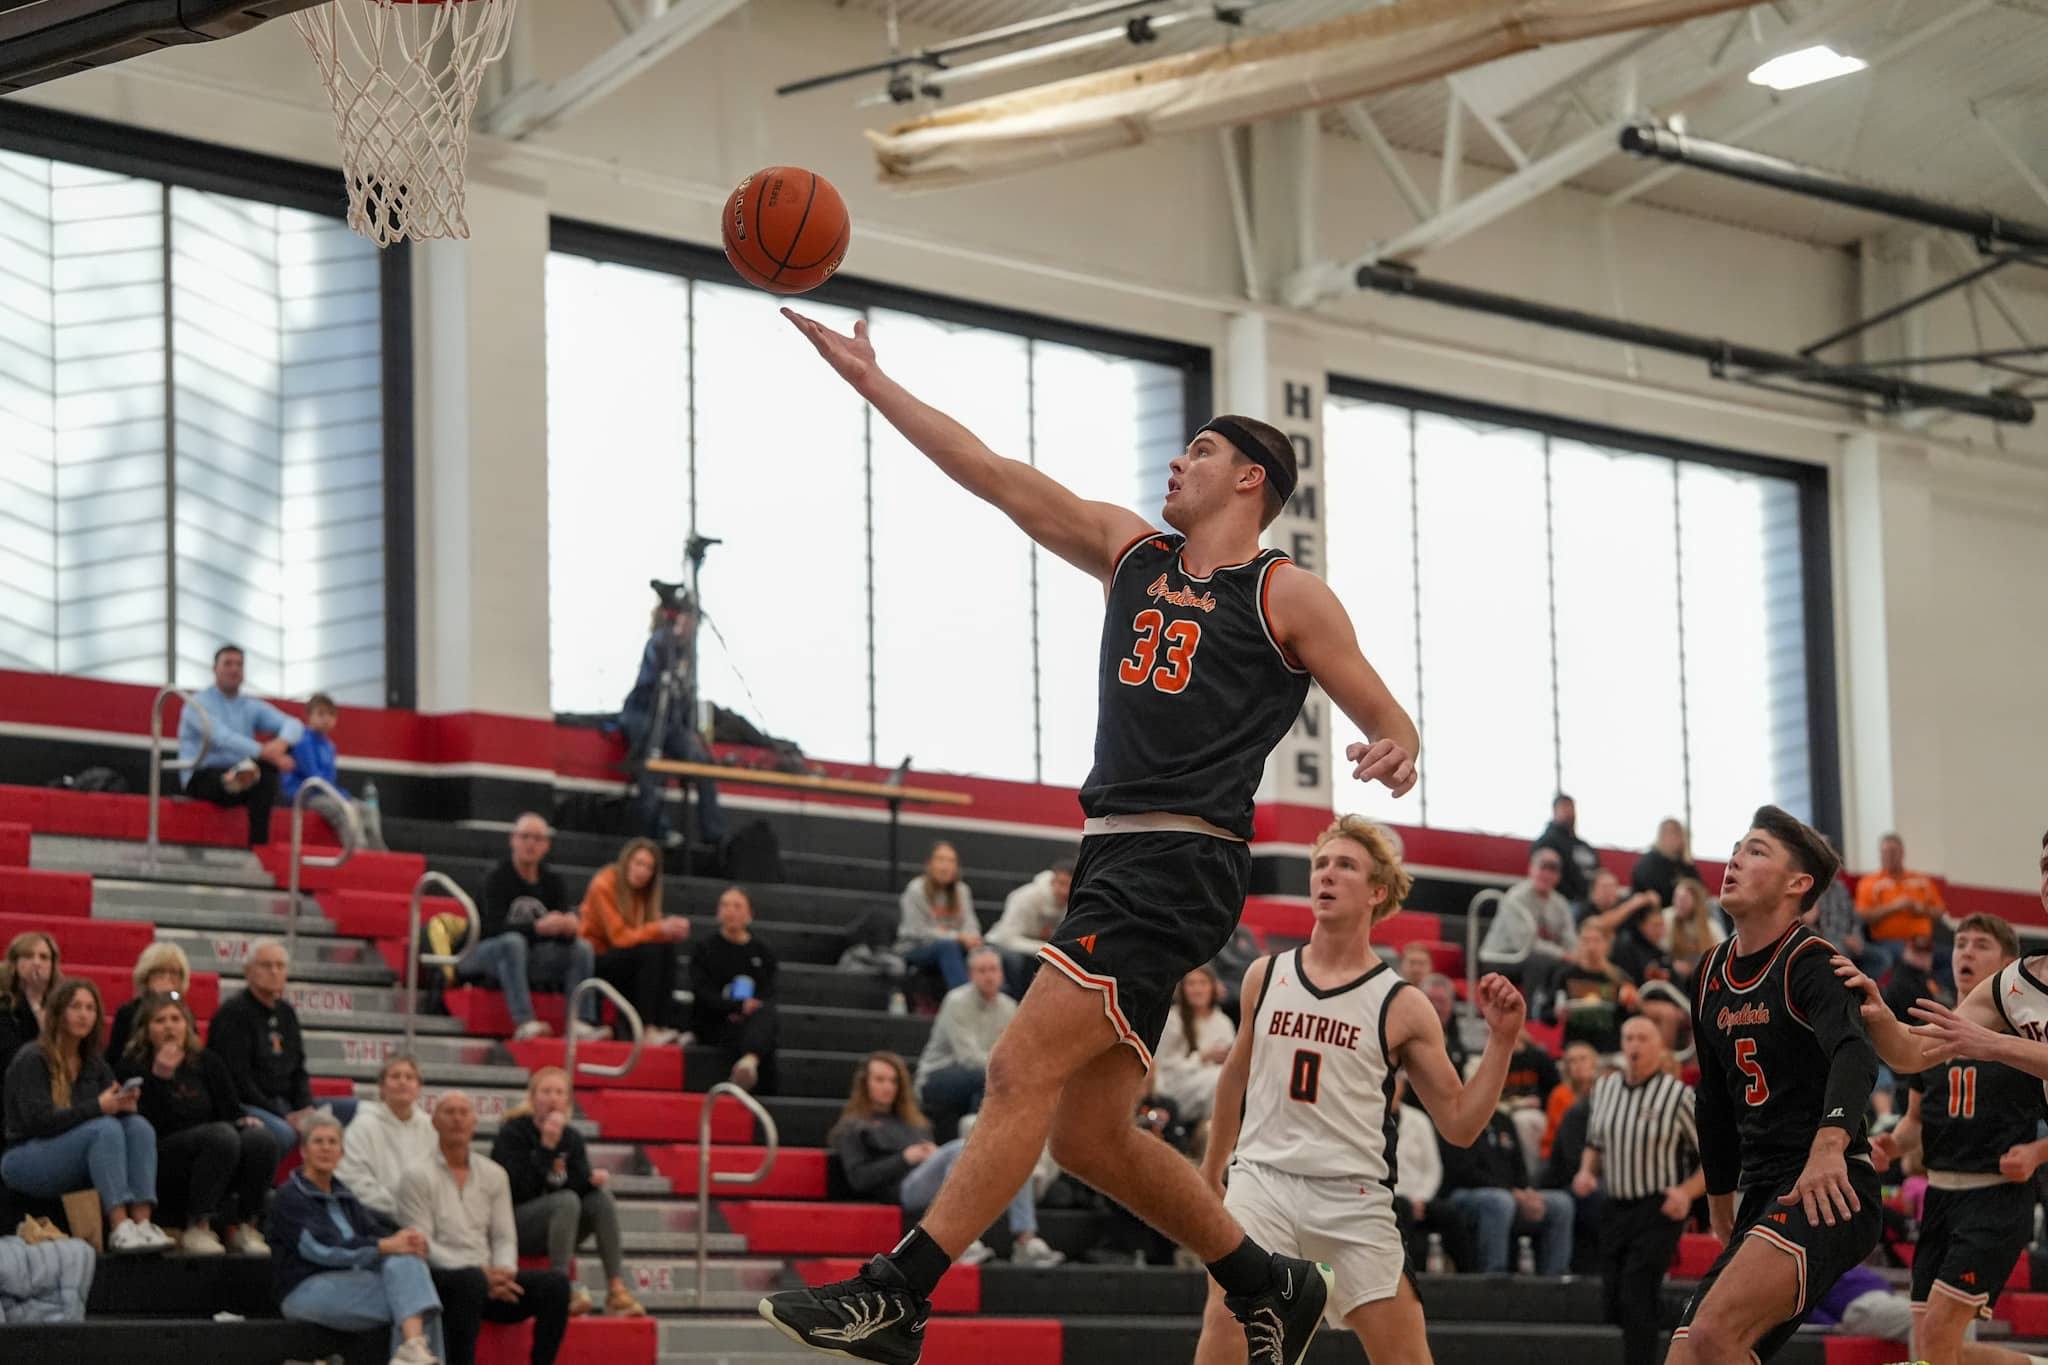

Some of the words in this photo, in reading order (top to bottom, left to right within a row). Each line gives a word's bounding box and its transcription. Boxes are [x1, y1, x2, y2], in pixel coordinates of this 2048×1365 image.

[1118, 608, 1202, 694] 33
[1268, 1010, 1362, 1051] BEATRICE
[1289, 1048, 1322, 1104] 0
[1734, 1038, 1770, 1107] 5
[1947, 1065, 1977, 1118] 11
